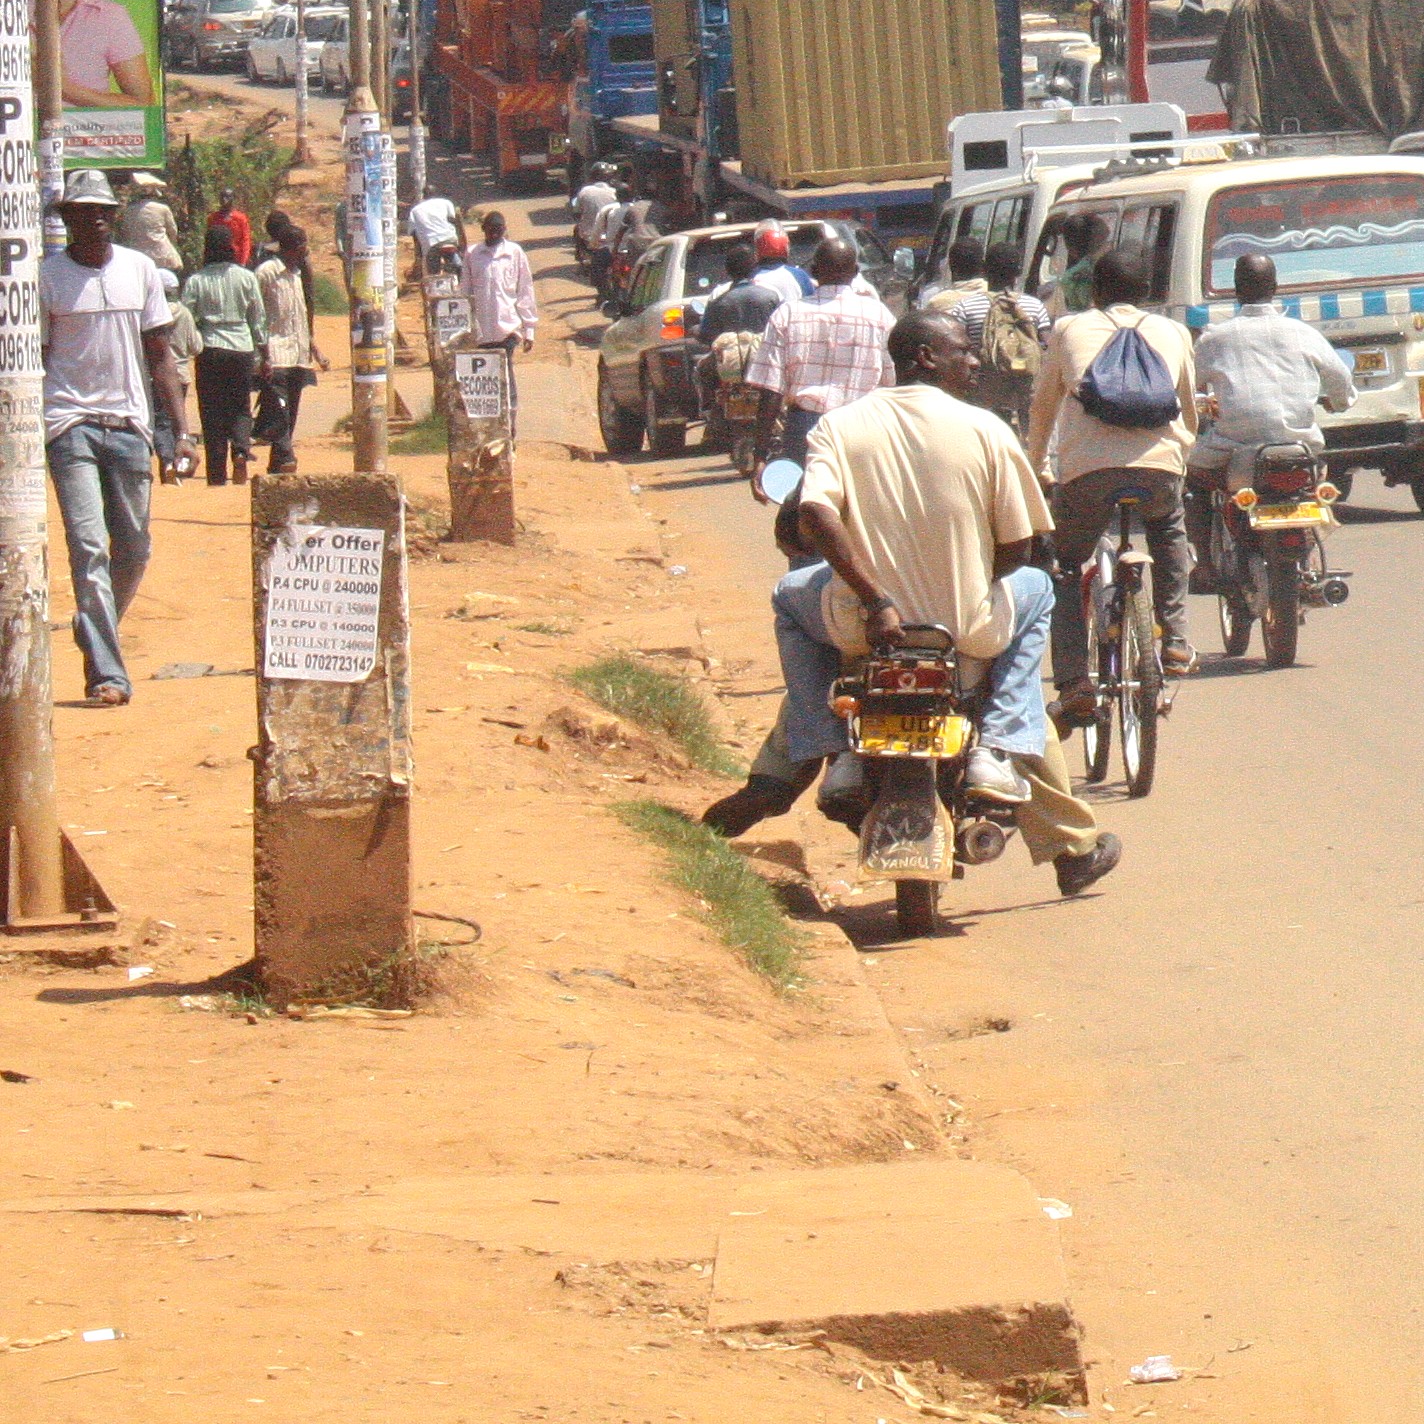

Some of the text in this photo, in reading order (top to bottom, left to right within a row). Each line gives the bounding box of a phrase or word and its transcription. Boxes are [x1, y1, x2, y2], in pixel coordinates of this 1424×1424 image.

[0, 238, 28, 275] P
[449, 302, 459, 314] P
[472, 357, 487, 374] P
[332, 534, 381, 551] Offer
[287, 555, 380, 576] OMPUTERS
[273, 577, 289, 588] P.4
[293, 578, 319, 591] CPU
[334, 580, 378, 594] 240000
[287, 598, 332, 614] FULLSET
[271, 619, 287, 628] P.3
[291, 619, 316, 629] CPU
[333, 622, 375, 633] 140000
[287, 636, 337, 650] FULLSET
[269, 652, 297, 668] CALL
